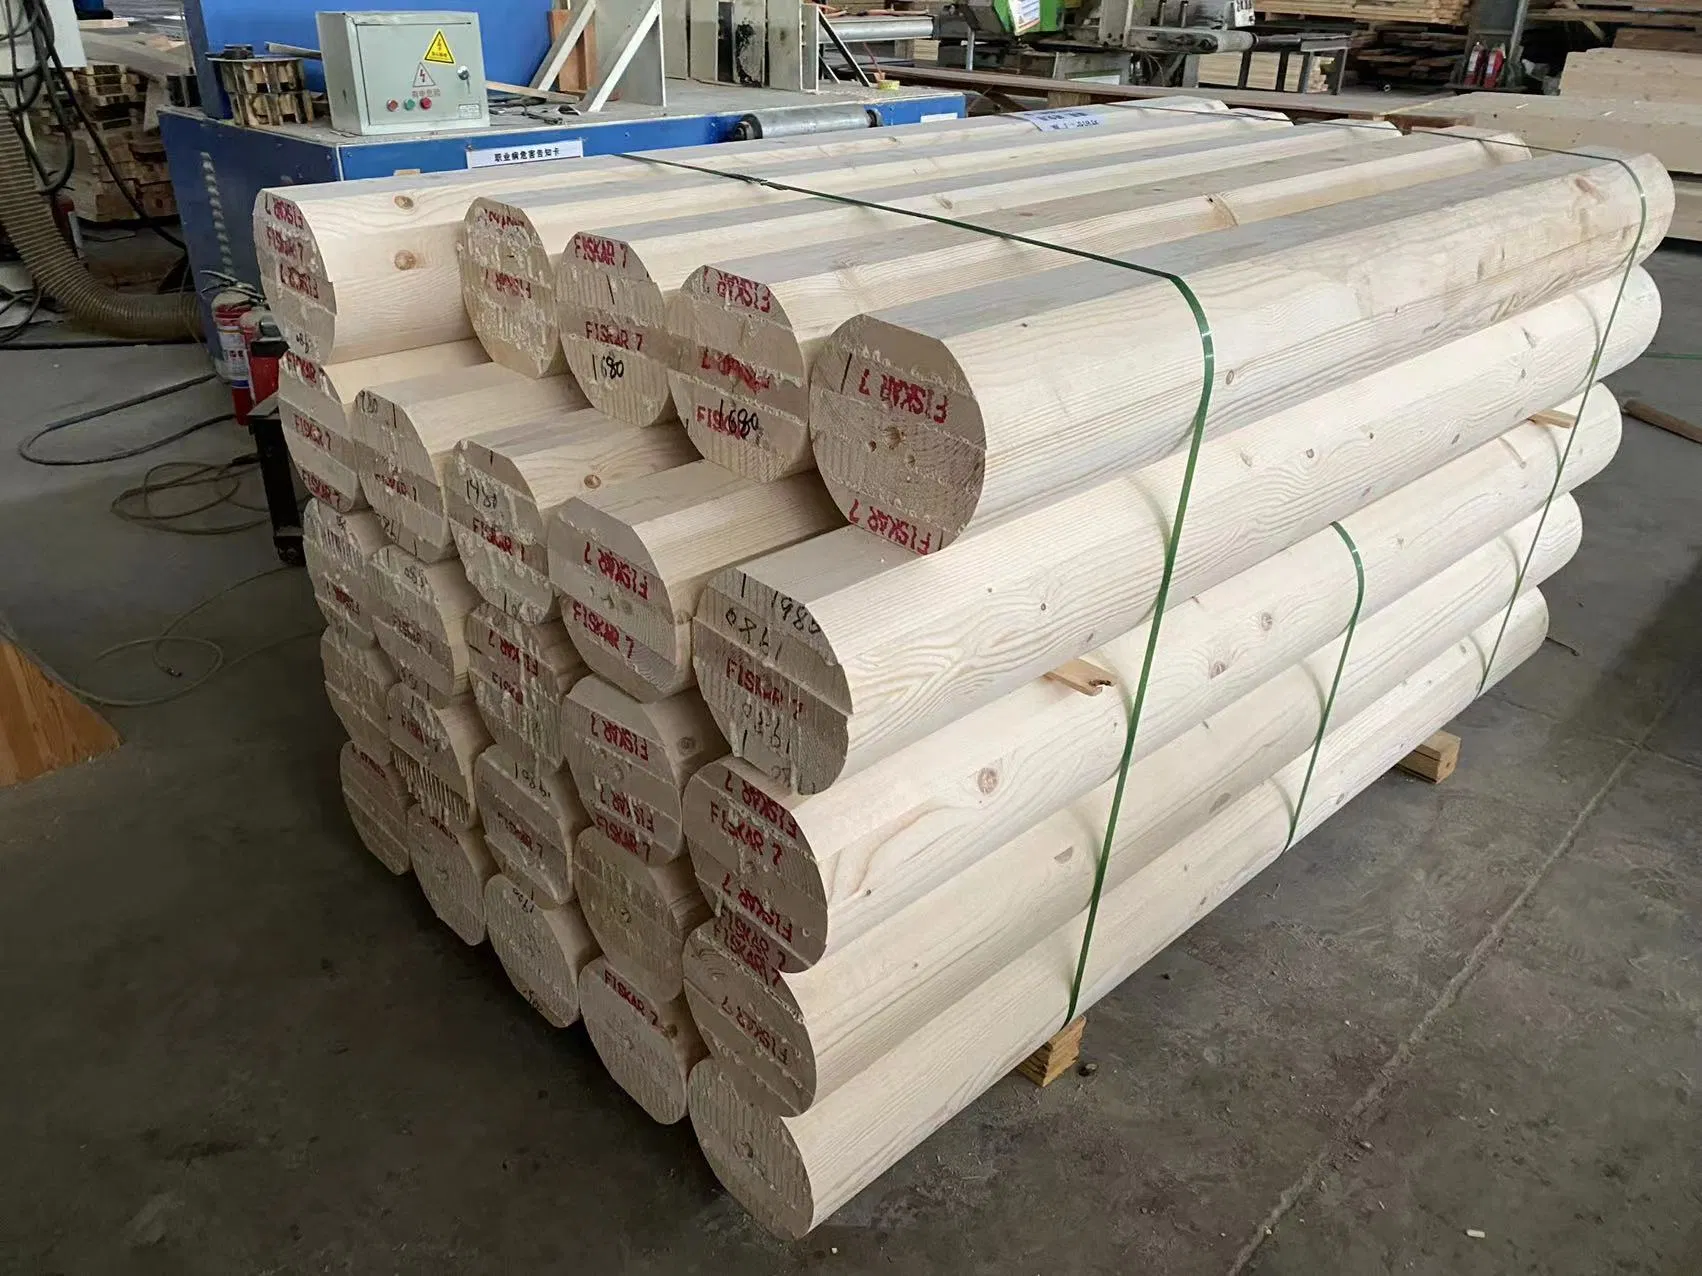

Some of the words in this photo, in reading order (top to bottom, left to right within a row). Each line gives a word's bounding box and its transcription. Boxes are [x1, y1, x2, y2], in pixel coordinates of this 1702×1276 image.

[495, 147, 560, 162] 职业病危害告知卡
[574, 236, 616, 266] FISKAR
[619, 243, 628, 268] 7
[585, 321, 629, 350] FISKAR
[635, 333, 644, 352] 7
[858, 368, 870, 396] 7
[880, 373, 949, 424] FISKAR
[849, 499, 860, 524] 7
[867, 506, 931, 556] FISKAR
[584, 542, 592, 565] 7
[597, 548, 648, 600] FISKAR
[573, 600, 620, 650] FISKAR
[625, 635, 635, 659] 7
[590, 711, 598, 737] 7
[602, 720, 648, 761] FISKAR
[724, 770, 734, 793] 7
[604, 969, 645, 1018] FISKAR
